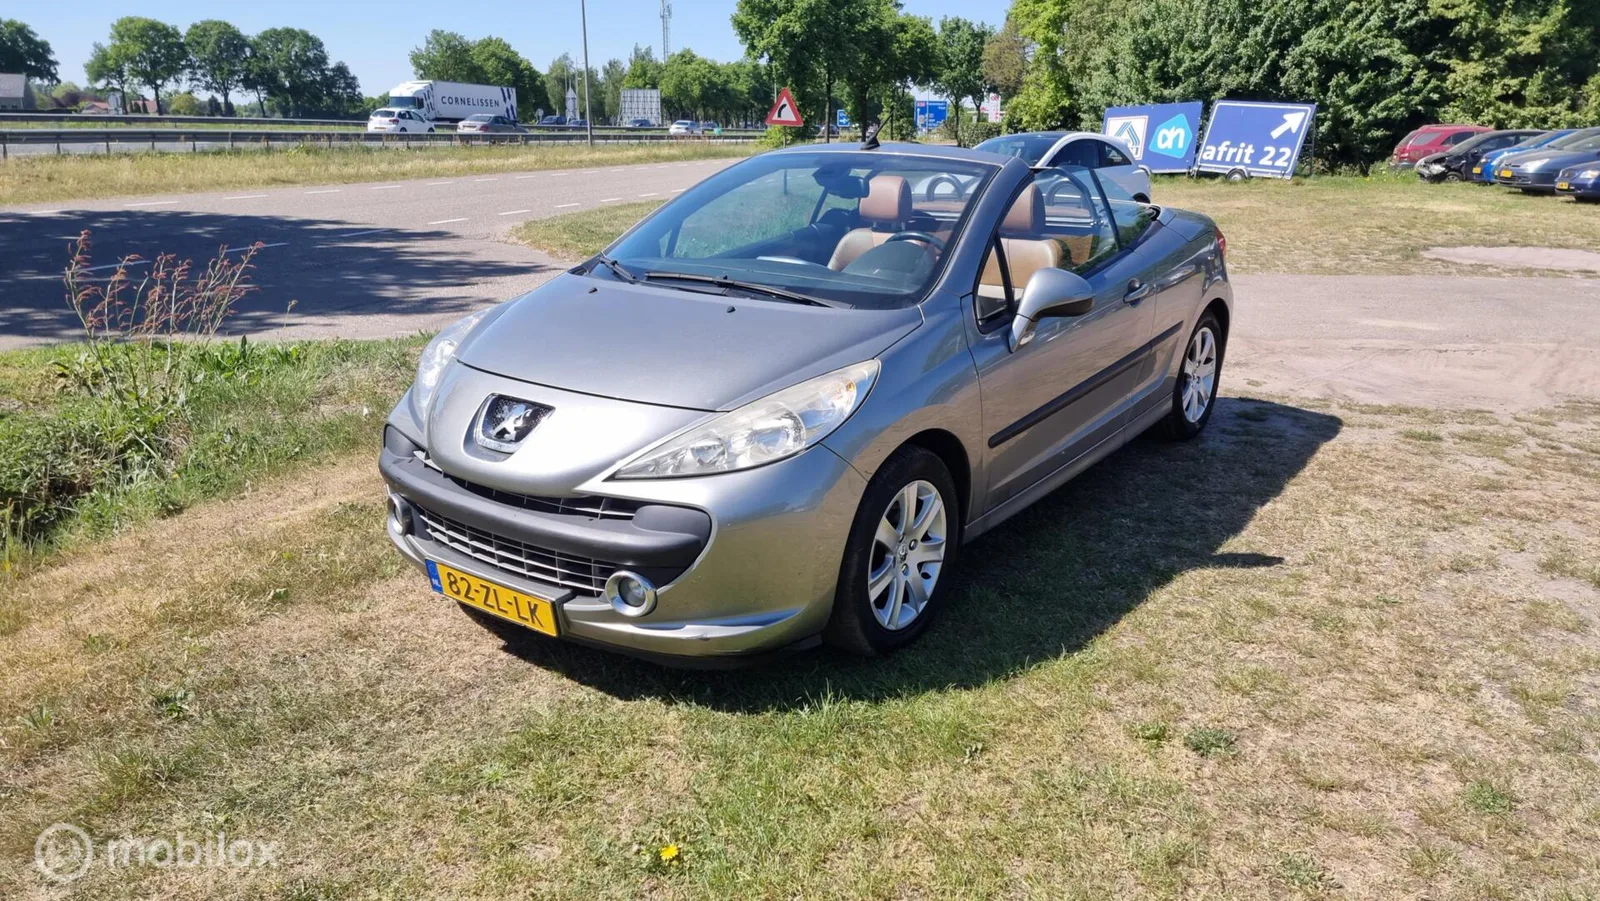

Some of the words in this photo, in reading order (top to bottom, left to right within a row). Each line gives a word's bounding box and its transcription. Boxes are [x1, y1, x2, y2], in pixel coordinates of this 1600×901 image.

[441, 95, 499, 108] CORNELISSEN
[1202, 140, 1255, 164] afrit
[1258, 146, 1292, 167] 22
[446, 571, 544, 628] 82-ZL-LK
